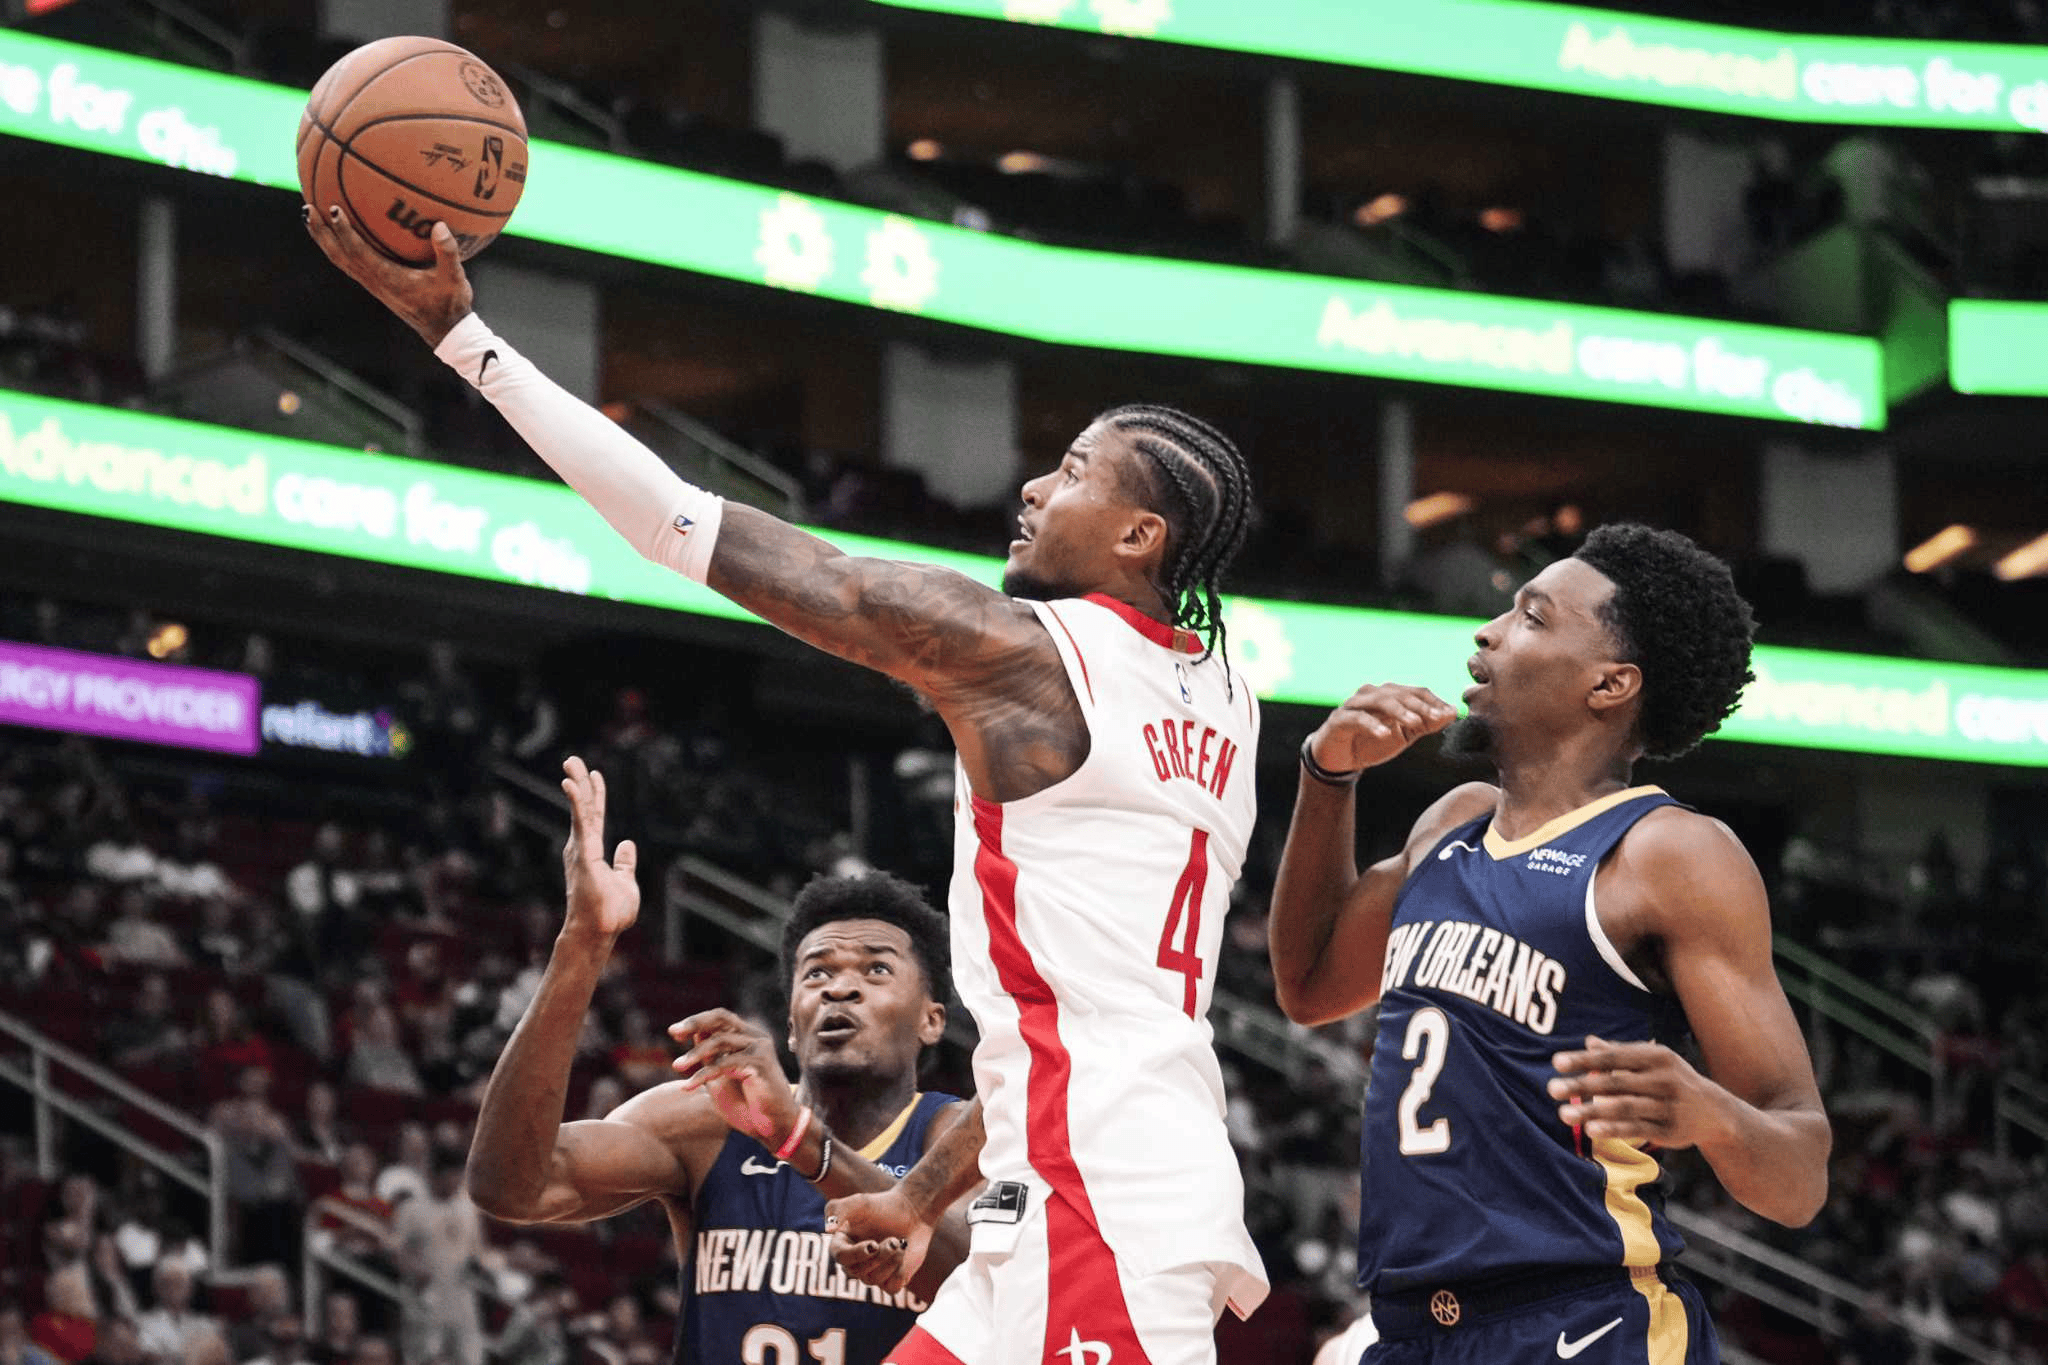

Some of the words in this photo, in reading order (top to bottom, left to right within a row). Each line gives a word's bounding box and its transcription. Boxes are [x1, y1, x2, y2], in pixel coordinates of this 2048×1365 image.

[49, 64, 133, 134] for
[274, 472, 395, 537] care
[404, 481, 486, 552] for
[73, 674, 242, 733] PROVIDER
[1143, 719, 1238, 800] GREEN
[1156, 827, 1210, 1022] 4
[1414, 920, 1567, 1035] ORLEANS
[1398, 1006, 1450, 1156] 2
[696, 1229, 777, 1295] NEW
